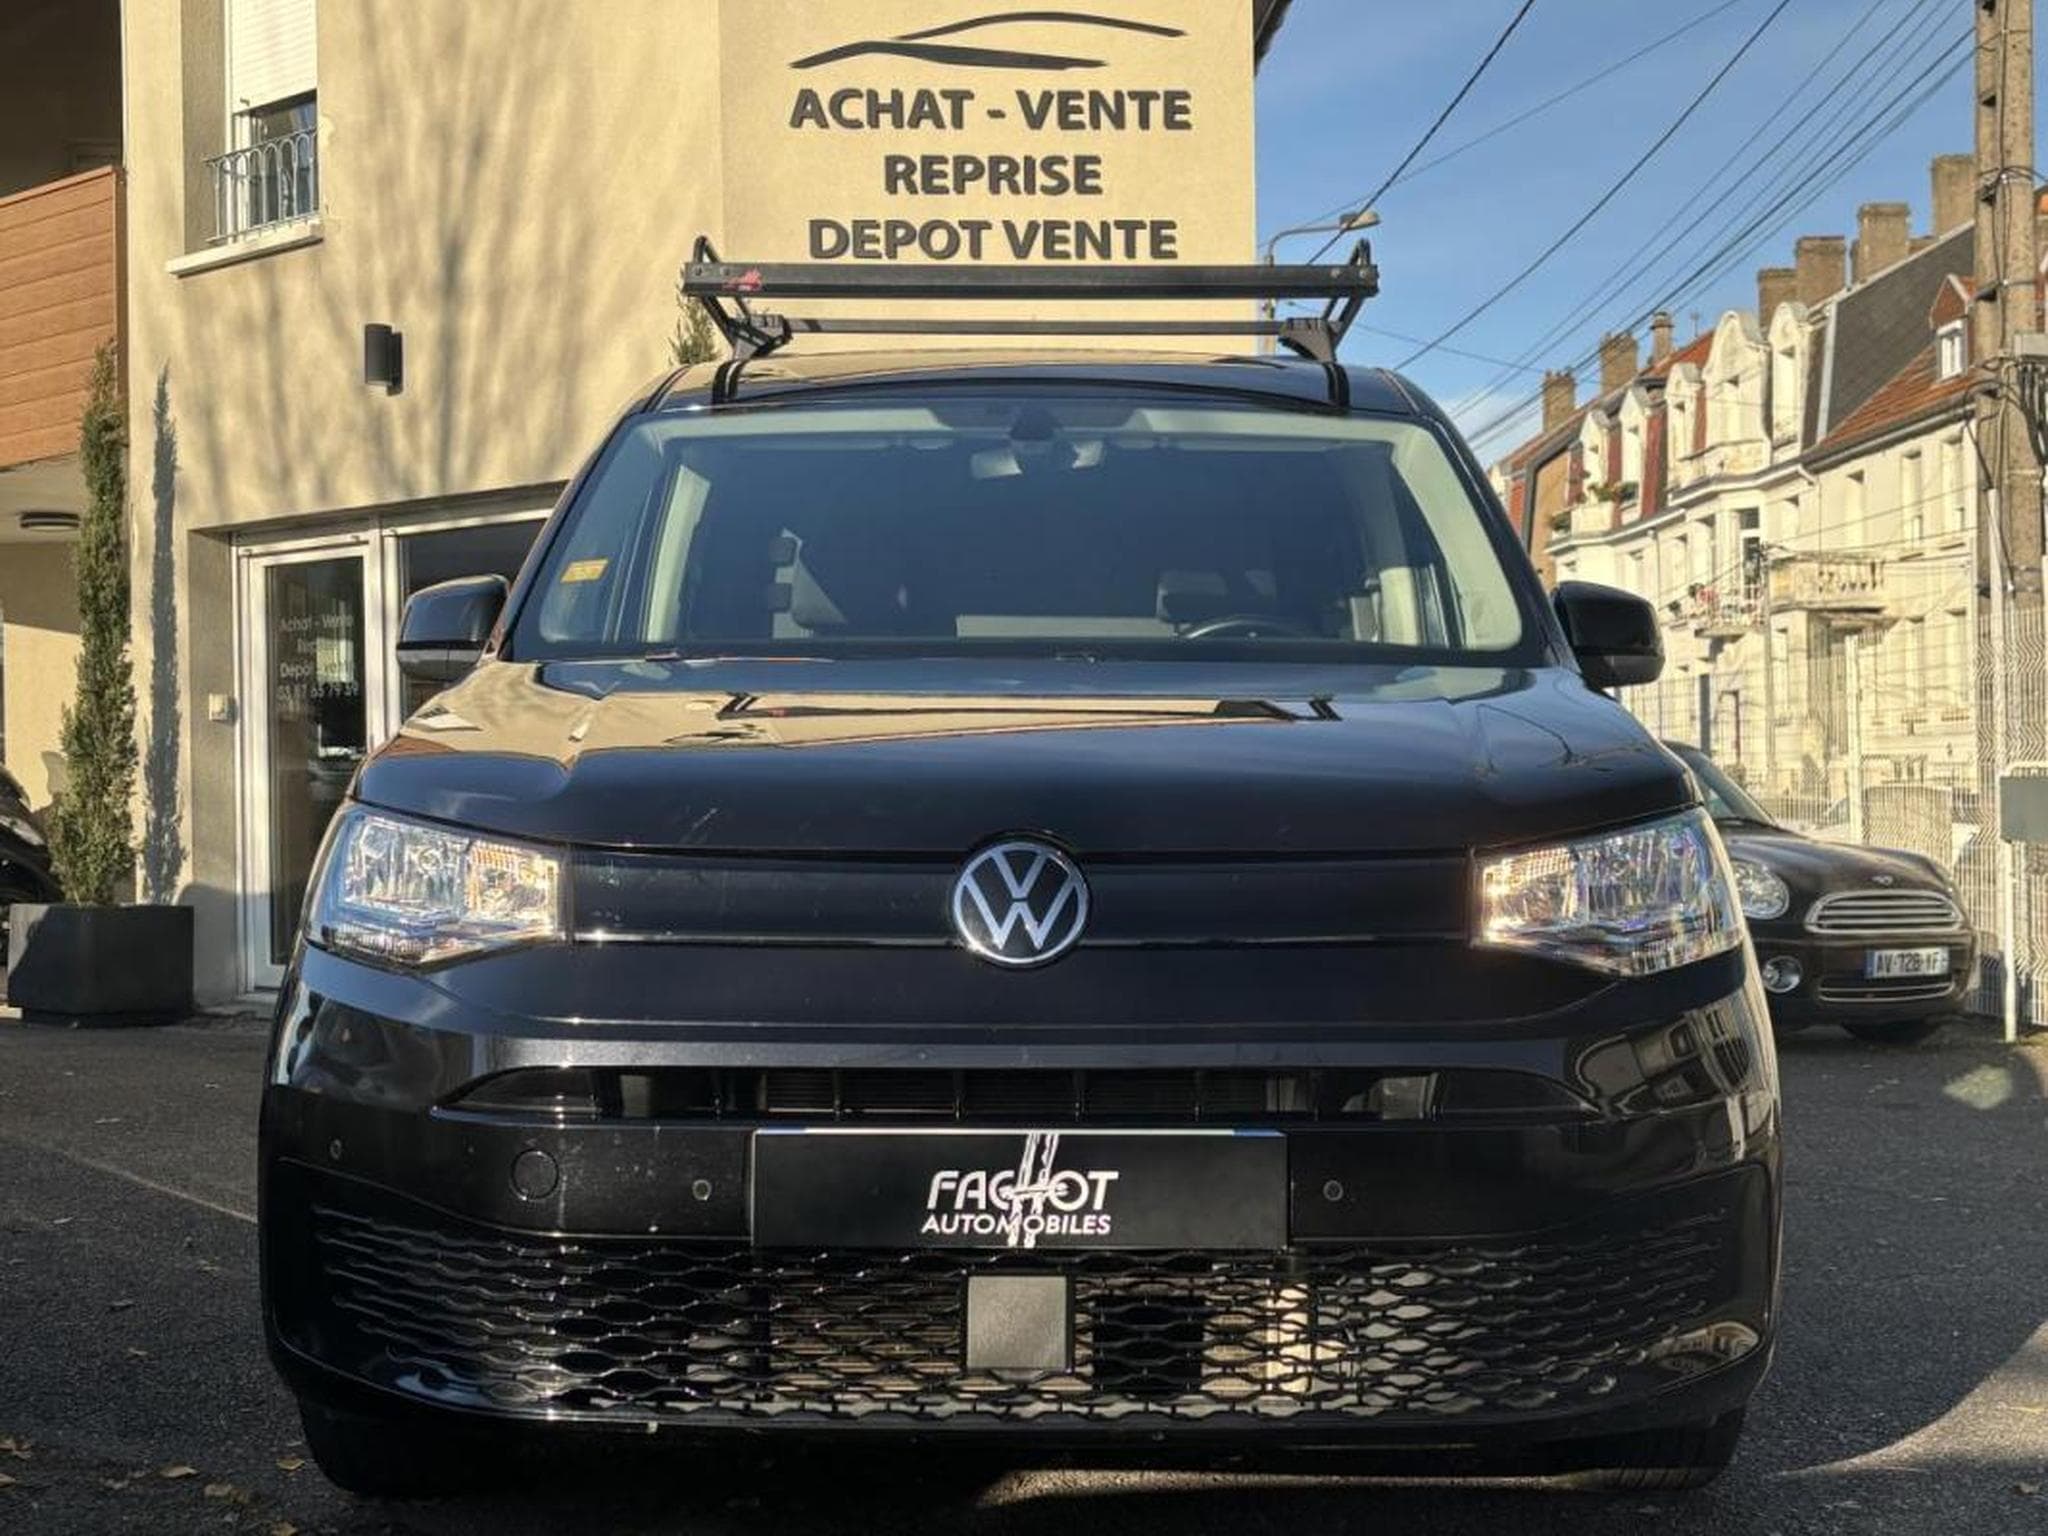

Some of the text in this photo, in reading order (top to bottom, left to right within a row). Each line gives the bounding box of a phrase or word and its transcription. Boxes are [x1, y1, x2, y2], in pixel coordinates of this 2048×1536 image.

[789, 88, 1192, 131] ACHAT - VENTE
[884, 155, 1103, 196] REPRISE
[809, 219, 1178, 260] DEPOT VENTE
[921, 1213, 1112, 1235] AUTOMOBILES
